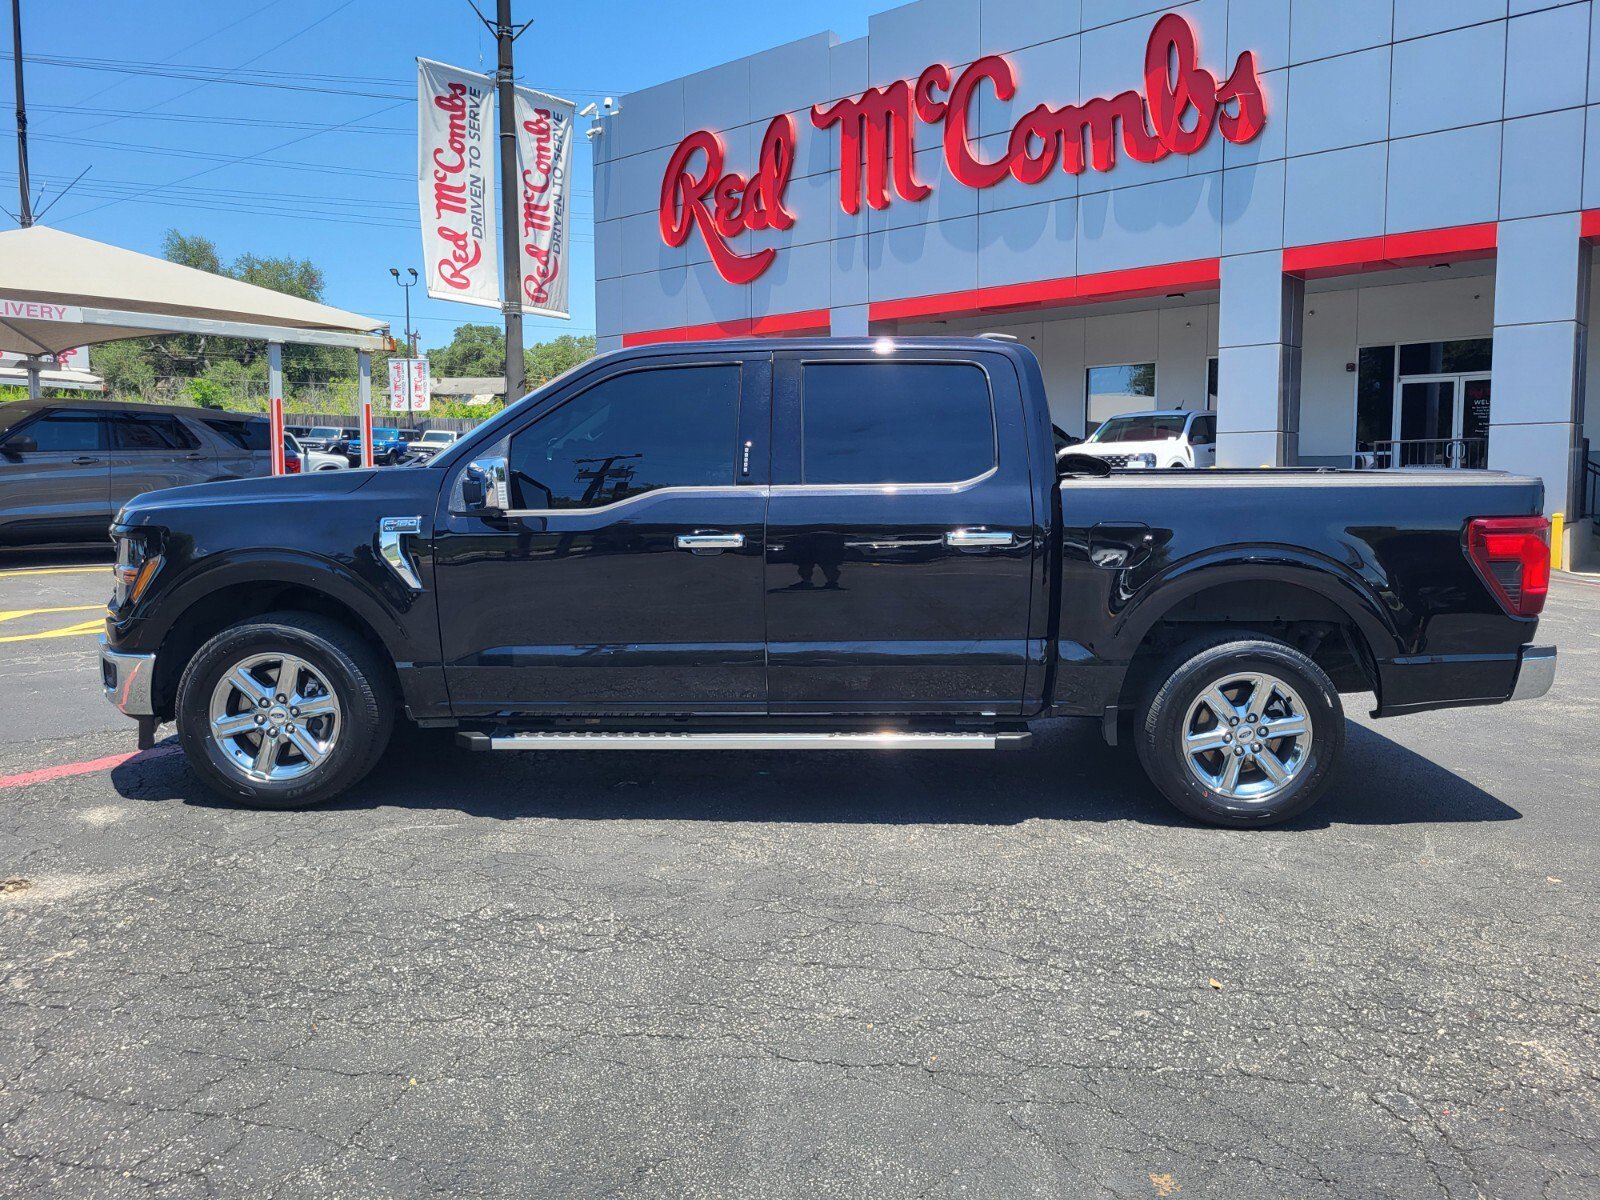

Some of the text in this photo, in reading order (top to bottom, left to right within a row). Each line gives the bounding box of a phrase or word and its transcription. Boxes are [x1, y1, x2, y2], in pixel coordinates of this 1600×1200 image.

[433, 83, 482, 290] Red McCombs
[468, 86, 483, 240] DRIVEN TO SERVE
[522, 107, 559, 304] Red McCombs
[551, 111, 564, 255] DRIVEN TO SERVE
[659, 13, 1268, 285] Red McCombs
[0, 302, 67, 320] IVERY
